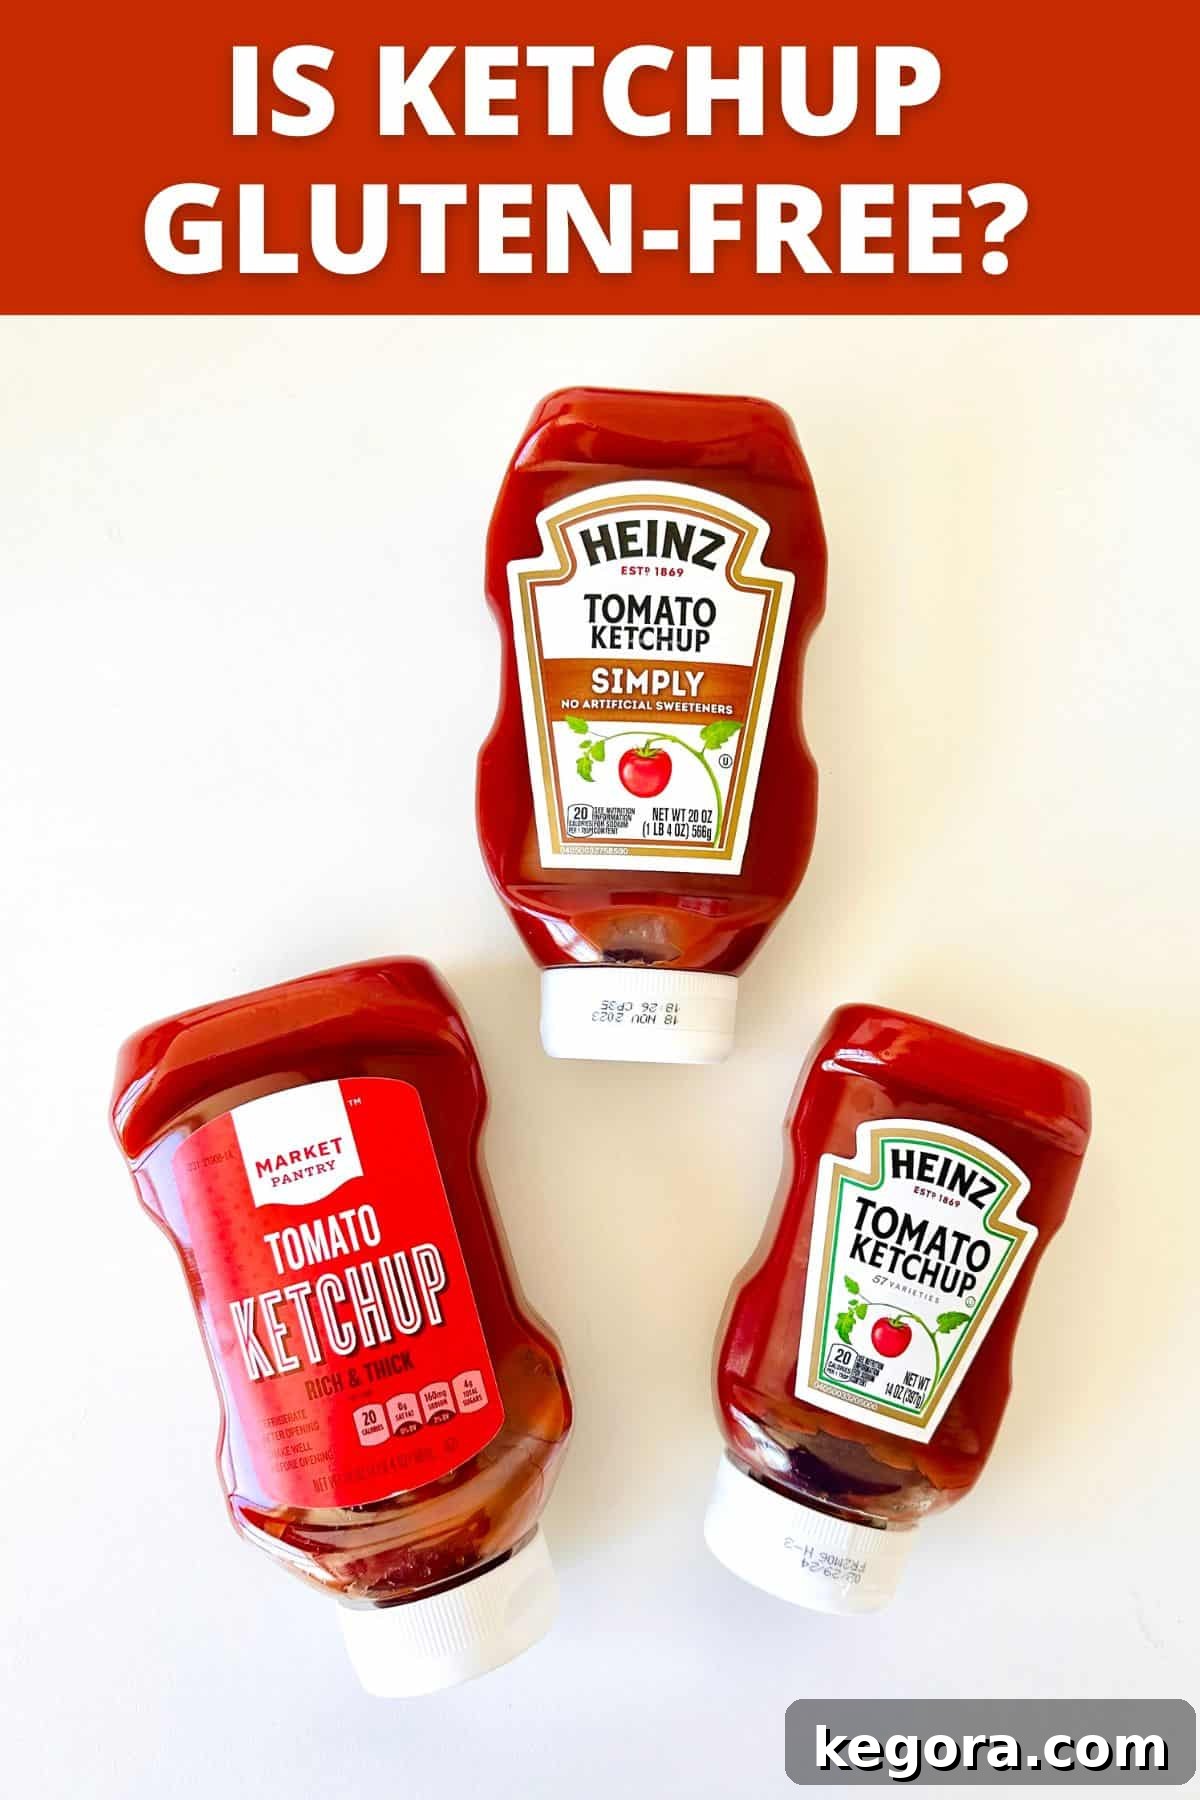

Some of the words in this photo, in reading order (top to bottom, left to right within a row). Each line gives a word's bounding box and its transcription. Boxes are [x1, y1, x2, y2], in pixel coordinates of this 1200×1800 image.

[579, 519, 726, 571] HEINZ
[655, 566, 684, 577] 1869
[584, 593, 717, 628] TOMATO
[591, 625, 710, 653] KETCHUP
[591, 667, 705, 697] SIMPLY
[561, 699, 579, 709] NO
[582, 699, 653, 712] ARTIFICIAL
[656, 701, 734, 715] SWEETENERS
[574, 807, 588, 820] 20
[652, 807, 669, 821] NET
[672, 808, 686, 822] WT
[688, 809, 700, 823] 20
[701, 809, 713, 824] OZ
[642, 821, 650, 838] (1
[653, 822, 664, 836] LB
[667, 823, 673, 836] 4
[674, 822, 690, 839] OZ)
[591, 1011, 624, 1023] 2023
[664, 1014, 677, 1025] 18
[255, 1137, 343, 1178] MARKET
[271, 1159, 337, 1188] PANTRY
[891, 1149, 997, 1210] HEINZ
[938, 1193, 961, 1208] 1869
[263, 1204, 381, 1275] TOMATO
[854, 1196, 991, 1273] TOMATO
[849, 1233, 977, 1298] KETCHUP
[872, 1274, 889, 1286] 57
[889, 1281, 940, 1304] VARIETIES
[229, 1243, 447, 1382] KETCHUP
[834, 1348, 851, 1365] 20
[305, 1374, 344, 1401] RICH
[349, 1367, 362, 1389] &
[363, 1350, 415, 1383] THICK
[903, 1371, 918, 1388] NET
[918, 1377, 931, 1391] WT
[885, 1382, 894, 1396] 14
[894, 1385, 903, 1399] OZ
[903, 1388, 926, 1409] (397g)
[361, 1410, 377, 1425] 20
